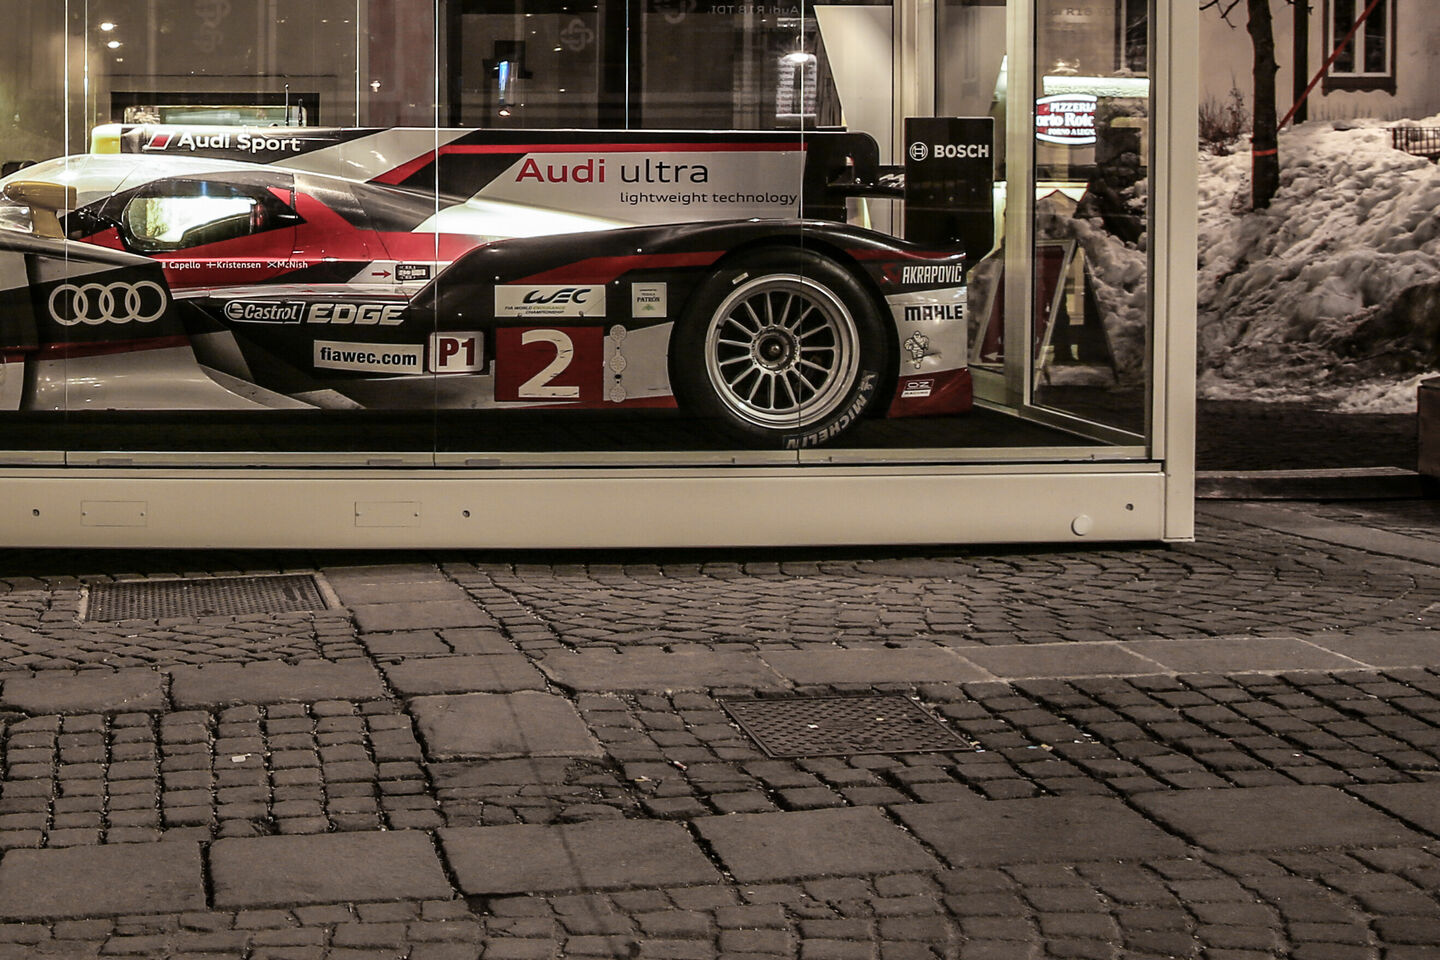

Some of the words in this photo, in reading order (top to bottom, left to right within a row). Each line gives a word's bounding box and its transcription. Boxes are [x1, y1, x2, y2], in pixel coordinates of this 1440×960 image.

[176, 131, 231, 151] Audi
[236, 132, 302, 153] Sport
[933, 143, 989, 159] BOSCH
[514, 157, 606, 184] Audi
[619, 158, 709, 184] ultra
[620, 191, 708, 207] lightweight
[712, 191, 798, 207] technology
[169, 261, 201, 271] Capello
[216, 261, 262, 269] Kristensen
[278, 261, 309, 269] McNish
[522, 287, 592, 304] WEC
[244, 302, 301, 321] Castrol
[307, 302, 408, 327] EDGE
[904, 304, 963, 322] MAHLE
[320, 343, 417, 369] fiawec.com
[438, 336, 476, 367] P1
[517, 328, 581, 398] 2
[786, 394, 868, 449] MICHELIN
